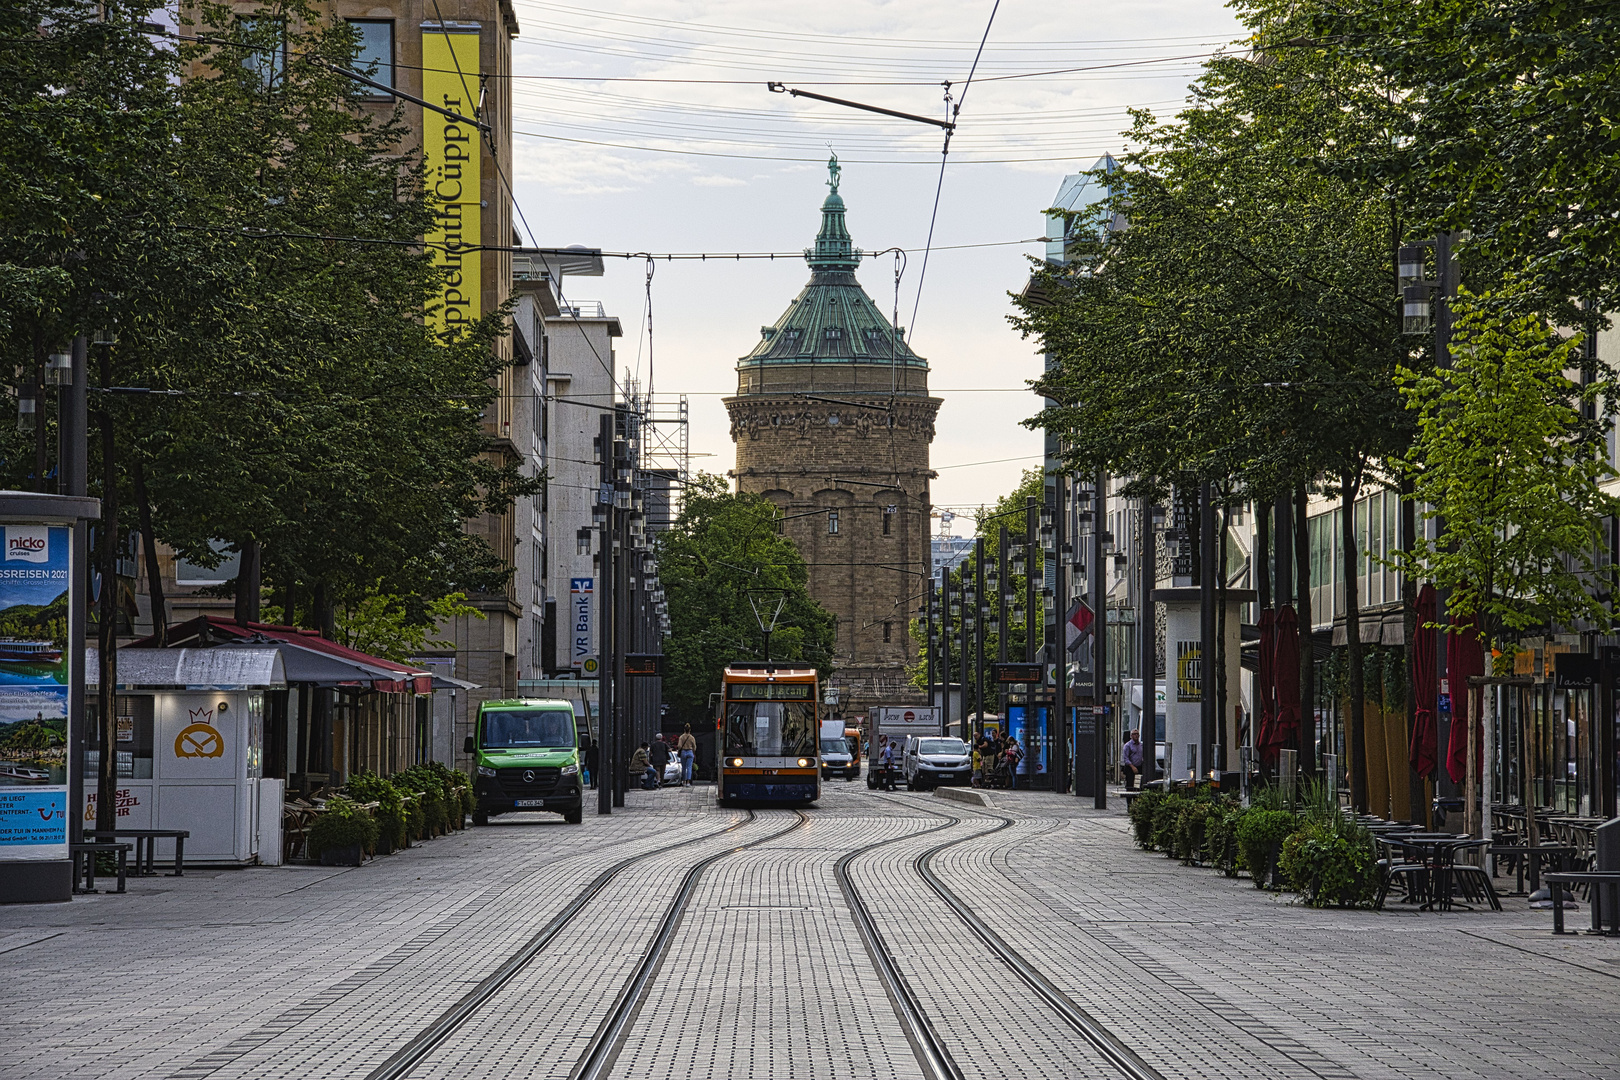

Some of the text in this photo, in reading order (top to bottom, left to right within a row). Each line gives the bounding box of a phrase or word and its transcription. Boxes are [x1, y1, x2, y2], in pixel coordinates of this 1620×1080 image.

[9, 537, 45, 549] nicko
[51, 570, 68, 579] 2021
[576, 596, 589, 656] VR Bank
